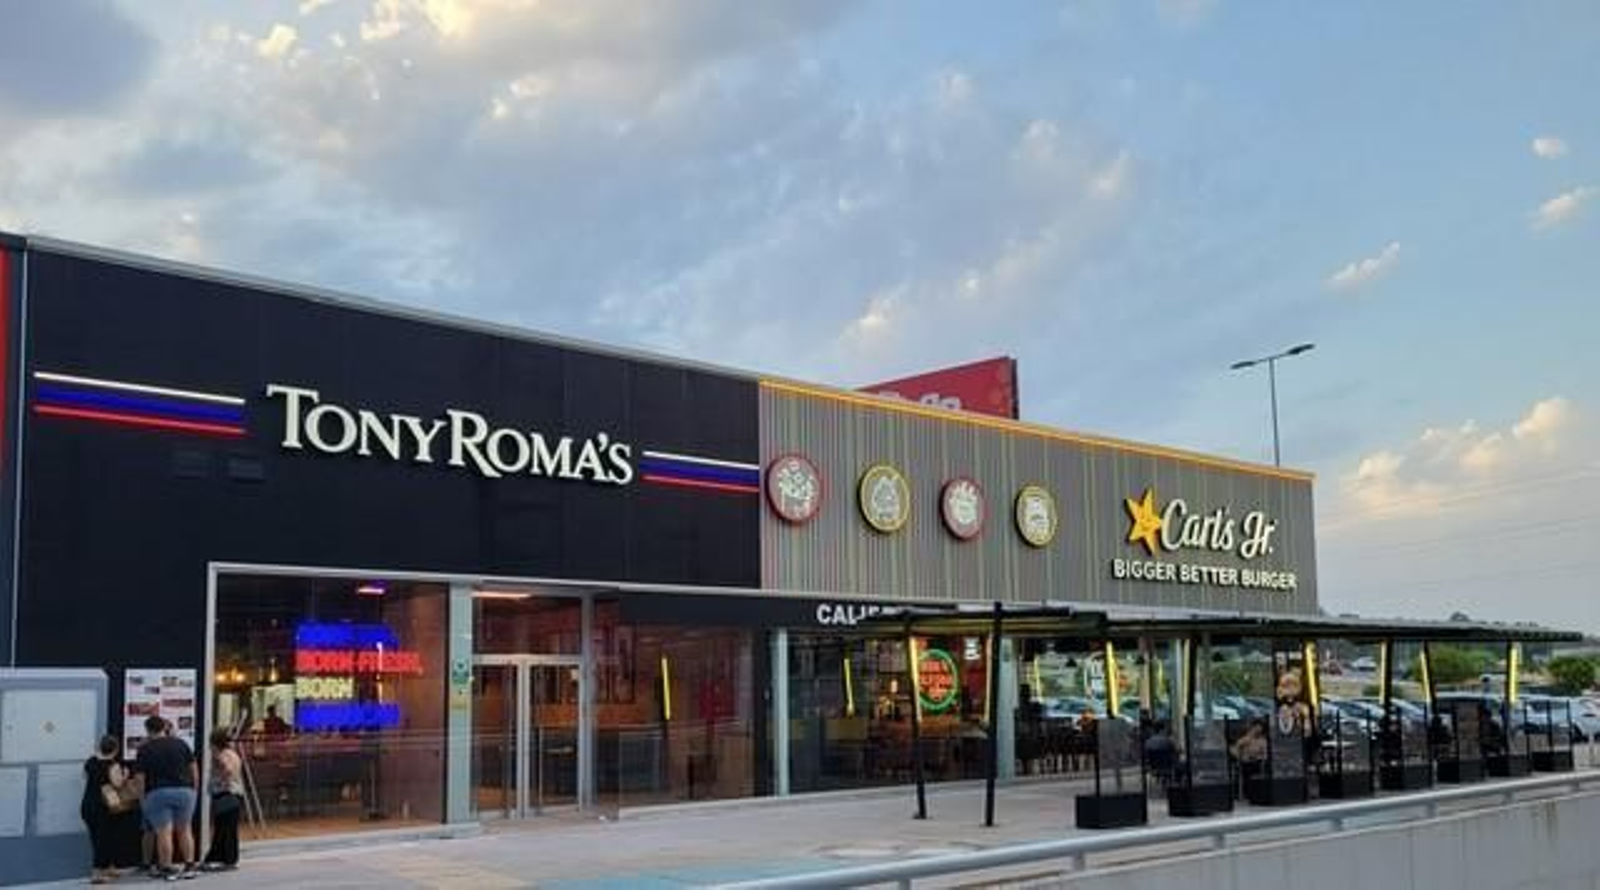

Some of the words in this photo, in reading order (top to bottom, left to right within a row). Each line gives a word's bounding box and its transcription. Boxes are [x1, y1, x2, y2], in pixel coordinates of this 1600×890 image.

[265, 383, 447, 463] TONY
[446, 408, 634, 485] ROMA'S
[1161, 498, 1235, 552] Carl's
[1240, 511, 1277, 560] Jr.
[1113, 558, 1177, 582] BIGGER
[1180, 563, 1239, 587] BETTER
[1241, 569, 1298, 590] BURGER
[295, 676, 354, 699] BORN
